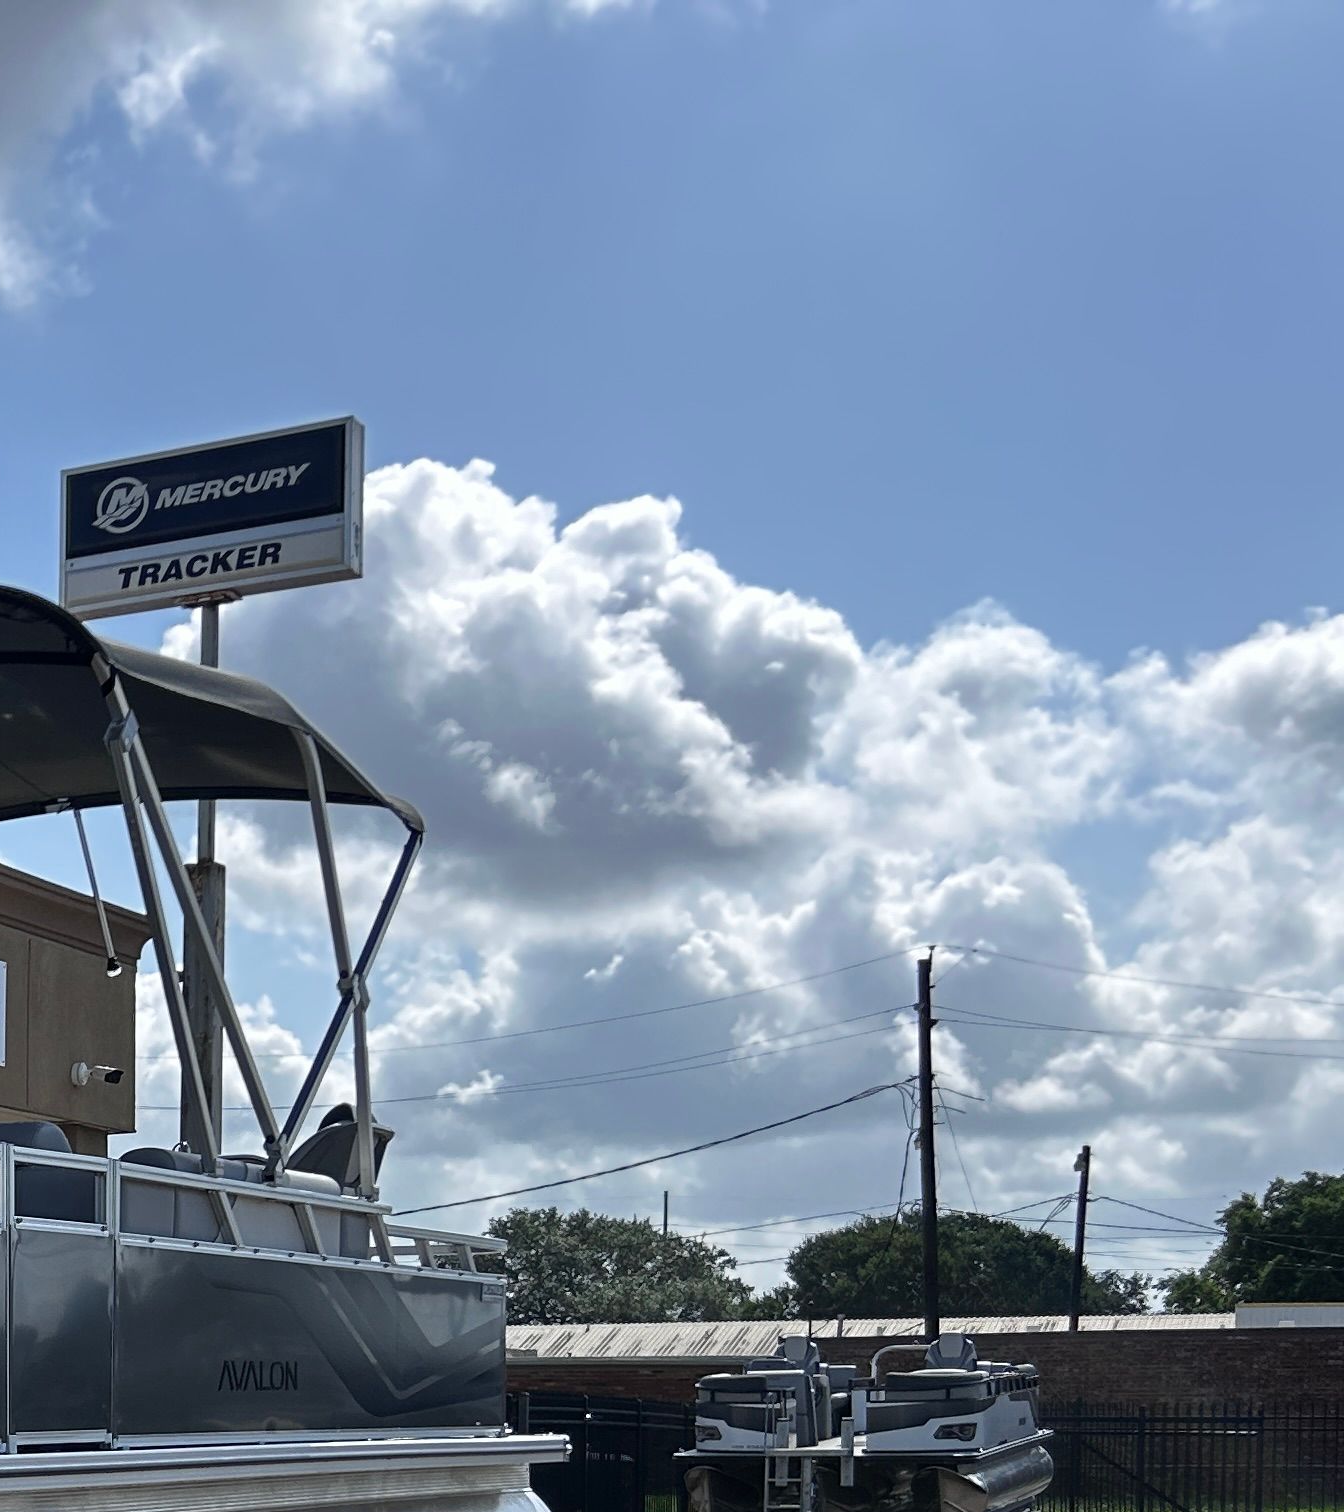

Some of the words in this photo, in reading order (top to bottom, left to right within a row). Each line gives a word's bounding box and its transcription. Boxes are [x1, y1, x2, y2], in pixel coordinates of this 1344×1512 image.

[154, 462, 312, 511] MERCURY
[117, 542, 282, 590] TRACKER
[217, 1360, 298, 1391] AVALON
